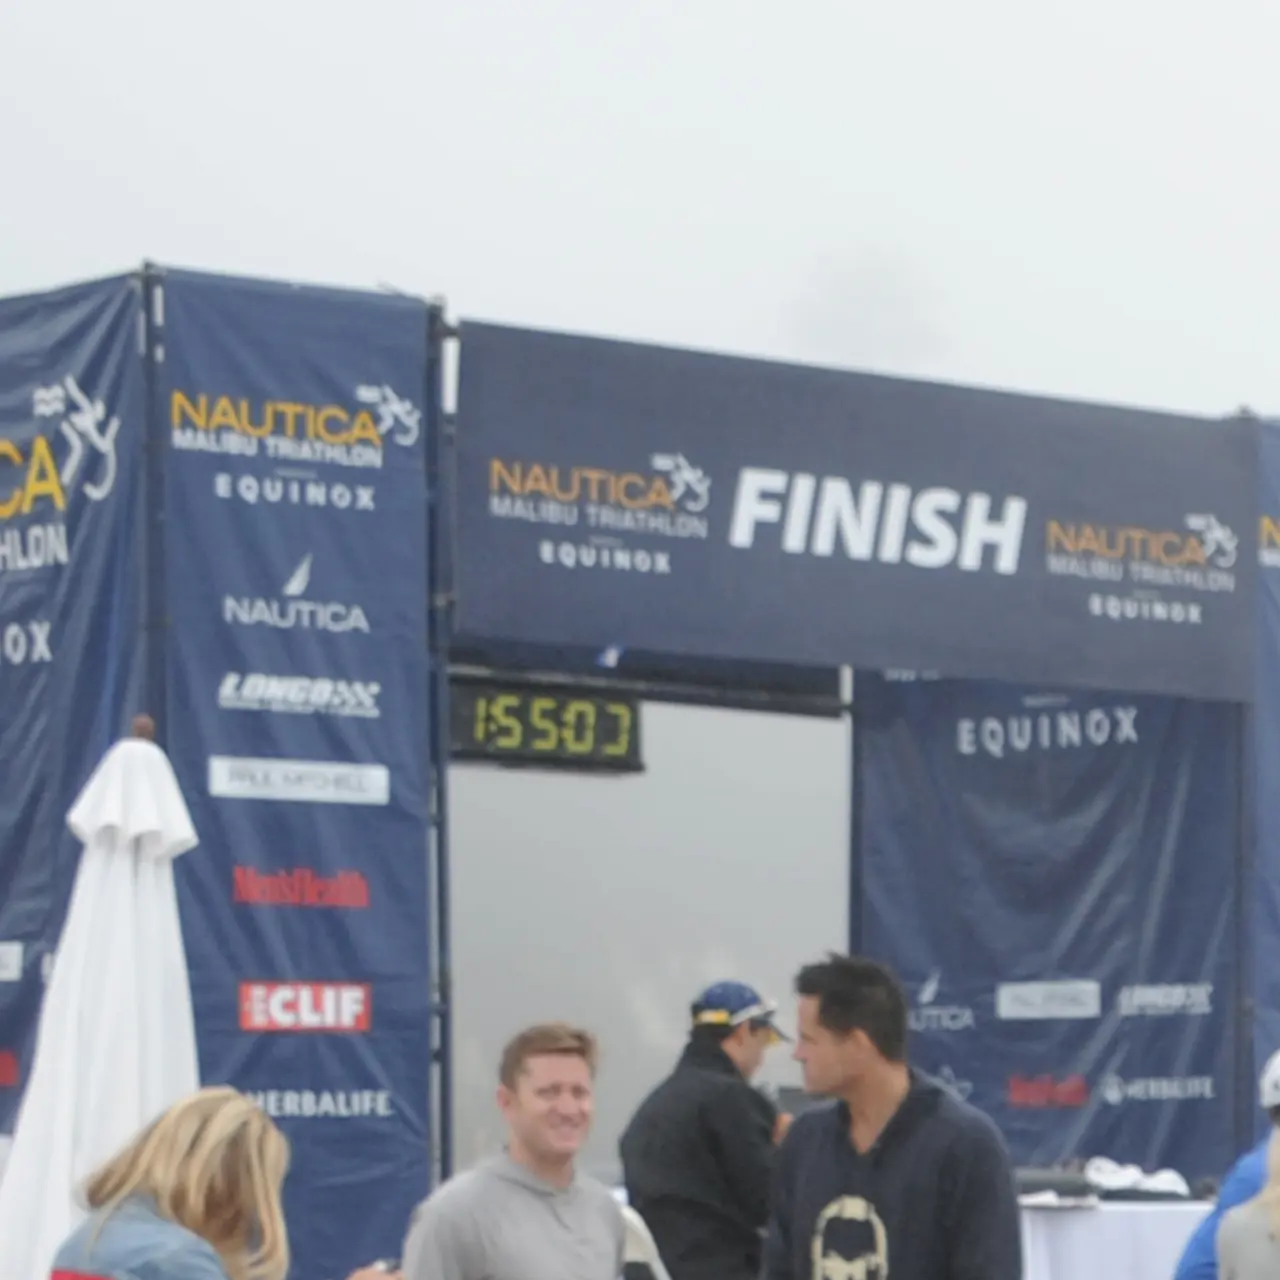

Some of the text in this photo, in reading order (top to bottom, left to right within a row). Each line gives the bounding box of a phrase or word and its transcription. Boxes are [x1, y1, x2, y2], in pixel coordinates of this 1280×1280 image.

[170, 389, 384, 446] NAUTICA
[214, 473, 376, 511] EQUINOX
[490, 458, 675, 510] NAUTICA
[490, 495, 708, 539] MALIBU TRIATHLON
[728, 466, 1028, 575] FINISH
[539, 540, 671, 574] EQUINOX
[1046, 521, 1206, 566] NAUTICA
[1046, 553, 1236, 592] MALIBU TRIATHLON
[224, 594, 370, 635] NAUTICA
[1088, 593, 1202, 625] EQUINOX
[956, 705, 1139, 759] EQUINOX
[269, 984, 366, 1028] CLIF
